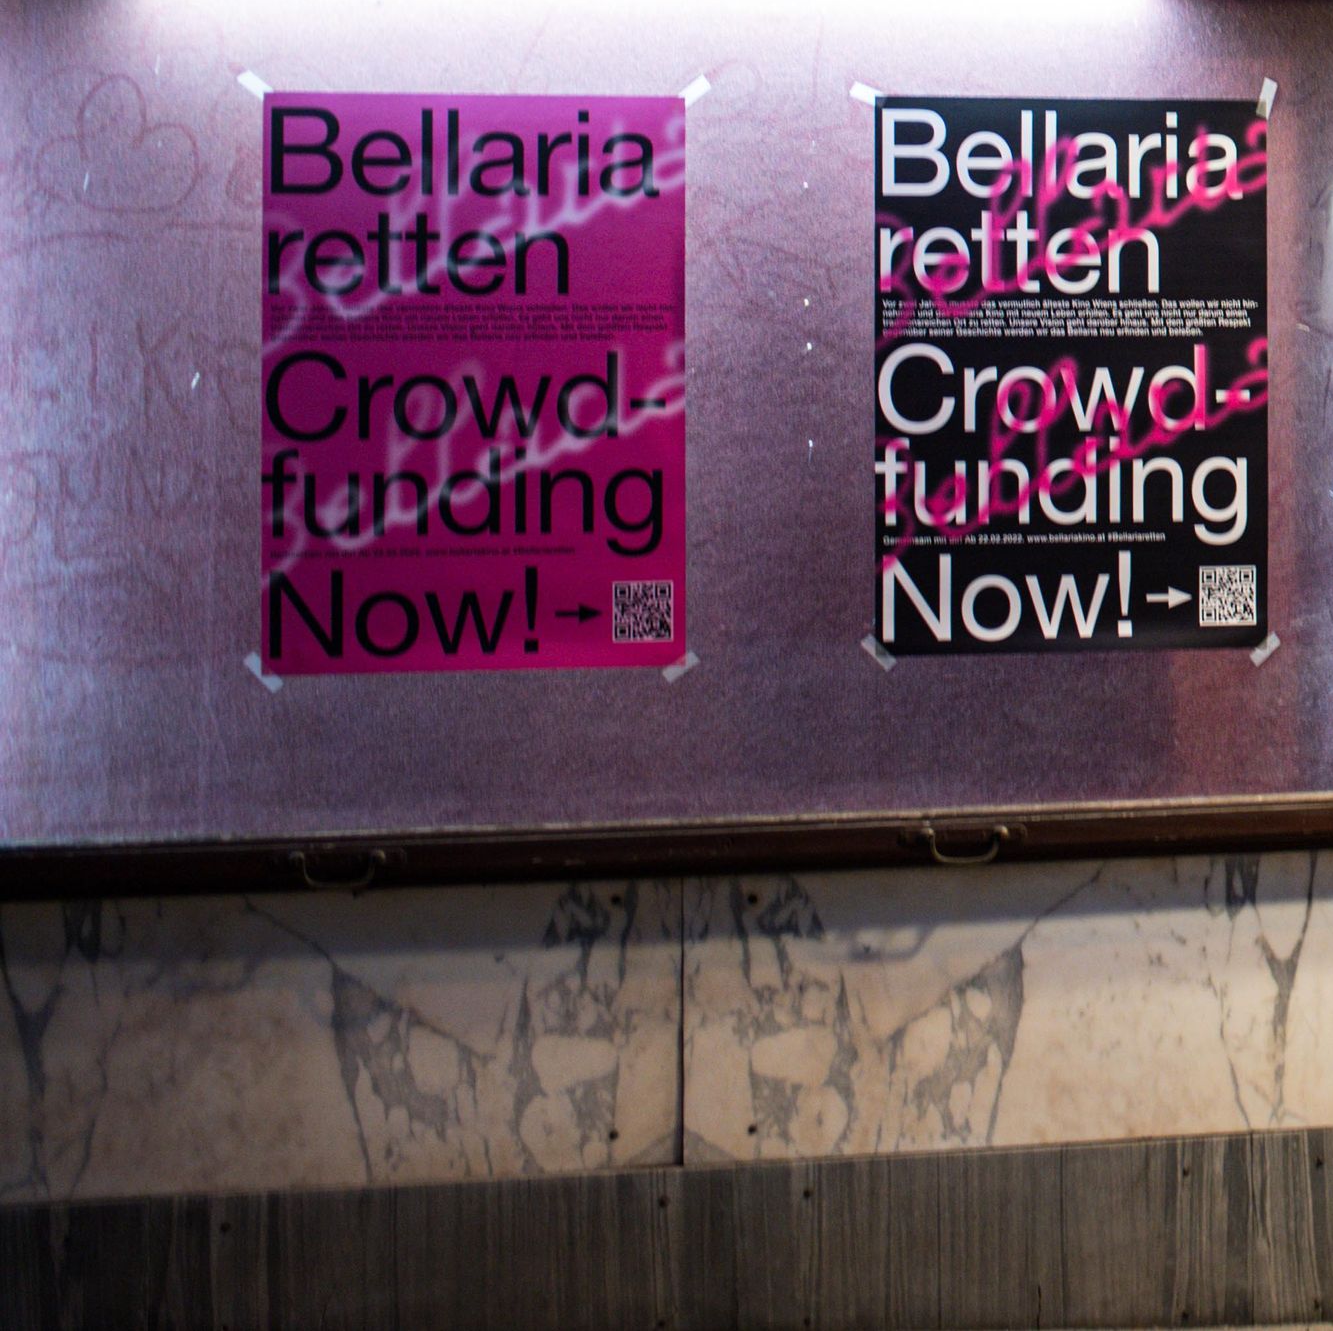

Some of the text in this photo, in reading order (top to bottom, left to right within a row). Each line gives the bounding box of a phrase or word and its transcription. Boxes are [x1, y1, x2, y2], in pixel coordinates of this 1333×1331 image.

[269, 106, 661, 200] Bellaria
[881, 106, 1245, 201] Bellaria
[267, 211, 571, 297] retten
[879, 210, 1161, 295] retten
[264, 349, 668, 444] Crowd-
[876, 342, 1252, 435] Crowd-
[261, 448, 665, 558] funding
[875, 436, 1250, 547] funding
[267, 566, 540, 659] Now!
[881, 549, 1134, 644] Now!
